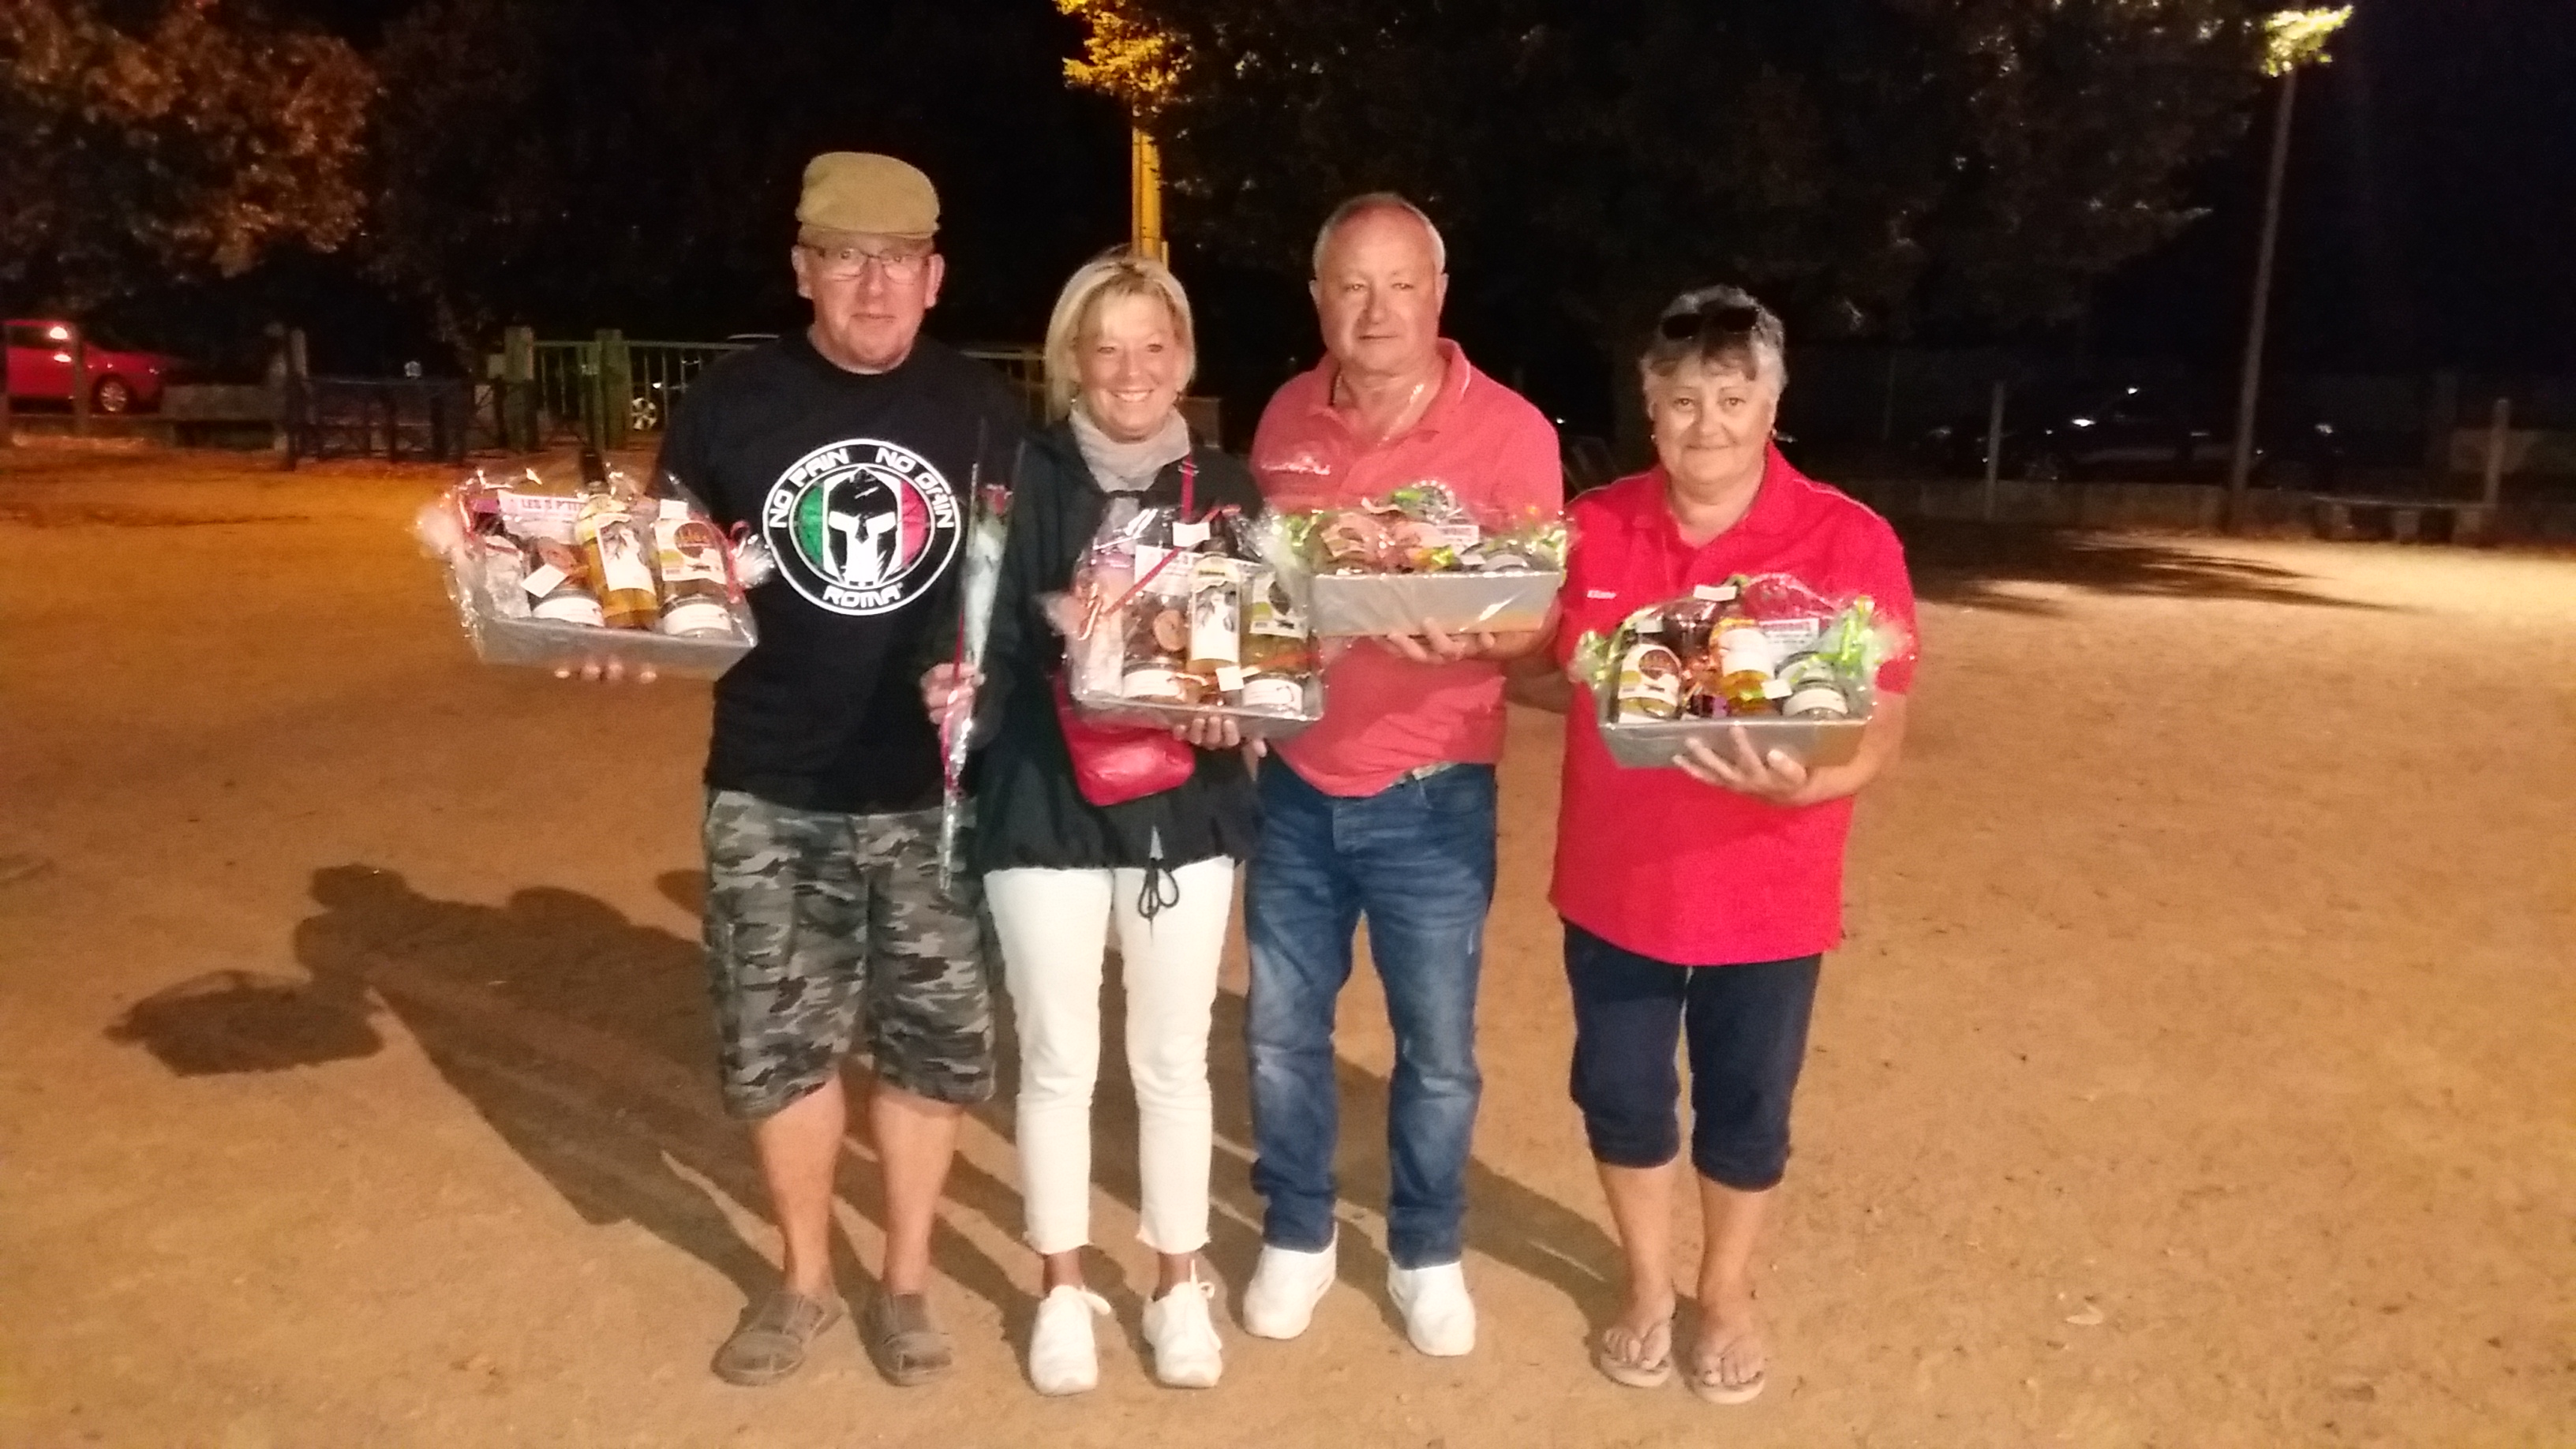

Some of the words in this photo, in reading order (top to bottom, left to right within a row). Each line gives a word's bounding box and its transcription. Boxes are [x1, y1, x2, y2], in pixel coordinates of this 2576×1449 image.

[769, 489, 794, 529] NO
[789, 447, 850, 488] PAIN
[875, 447, 916, 474] NO
[822, 584, 901, 608] ROMA
